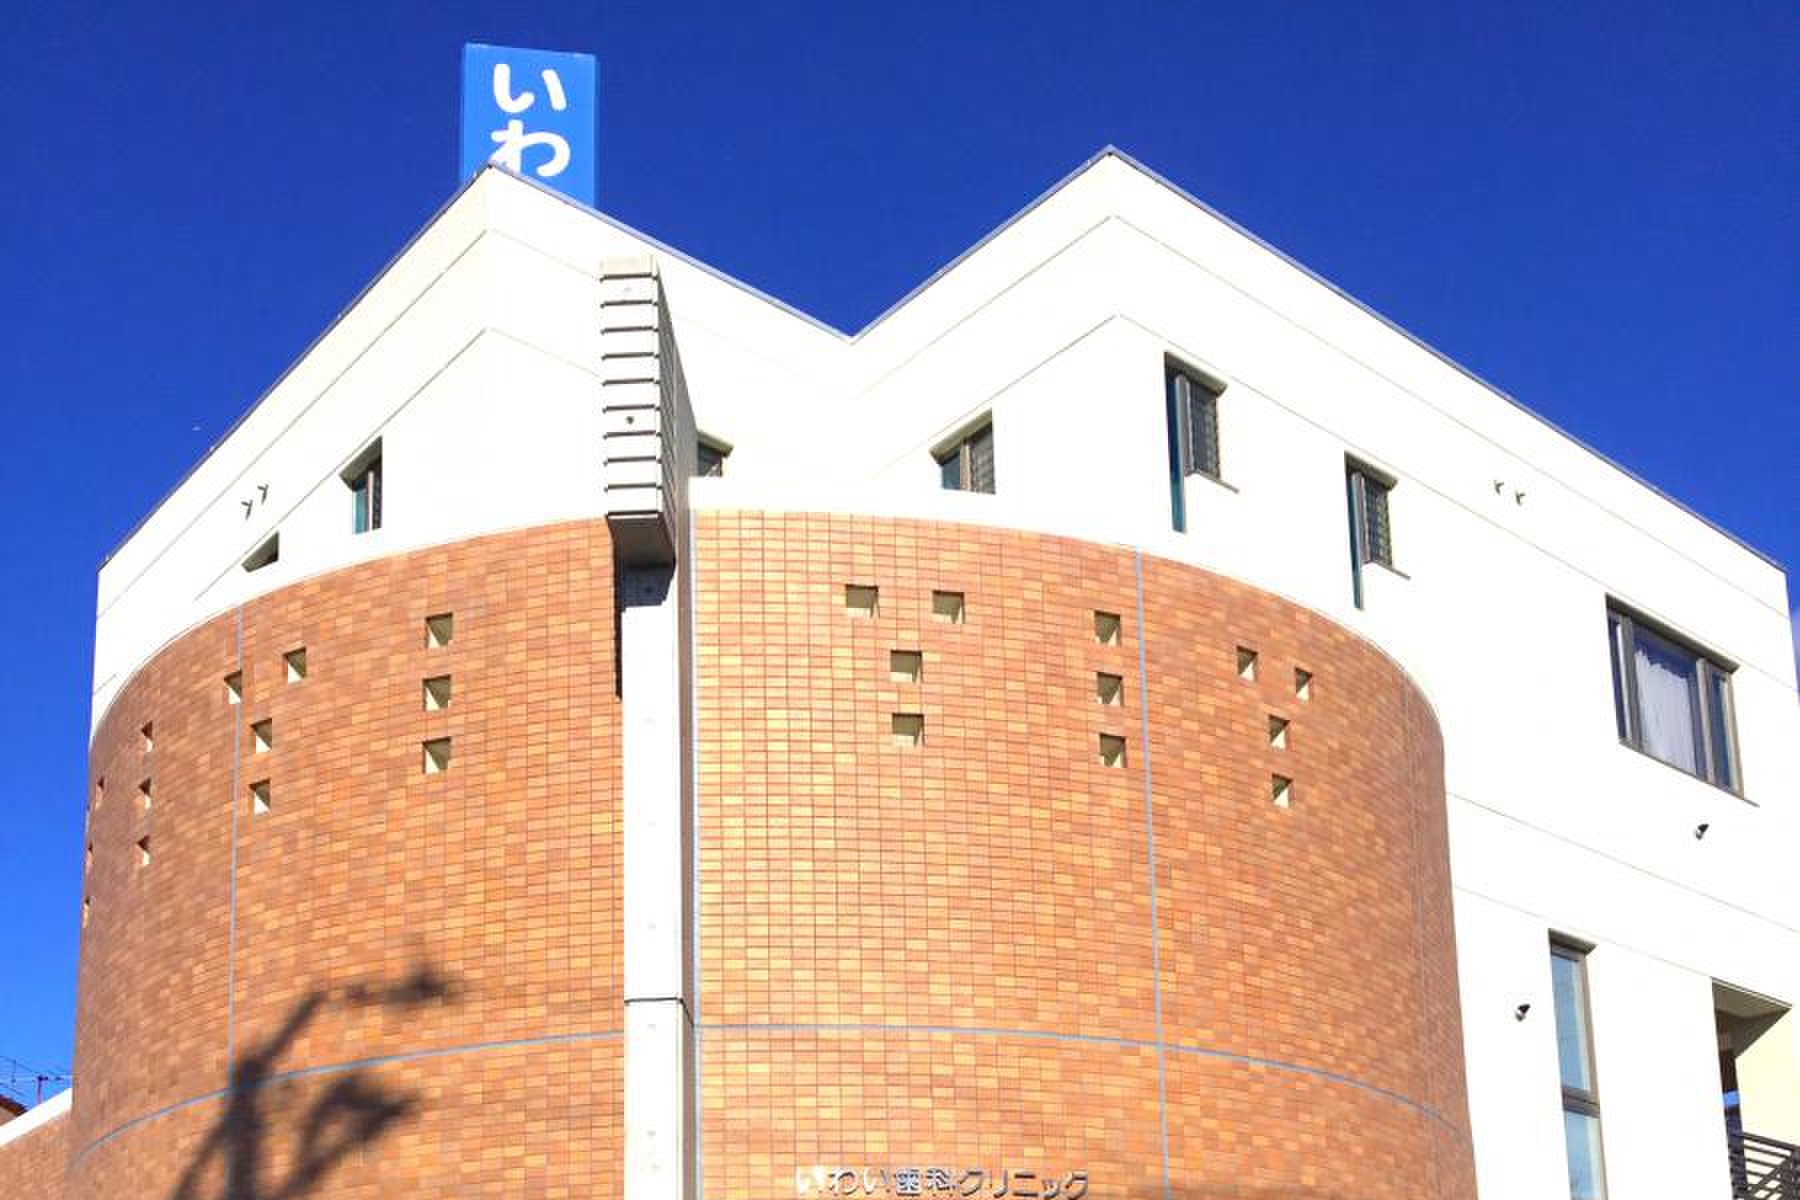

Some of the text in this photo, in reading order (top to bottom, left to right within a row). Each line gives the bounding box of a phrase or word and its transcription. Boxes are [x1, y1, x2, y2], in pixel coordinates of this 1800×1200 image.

[490, 63, 571, 176] いわ
[795, 1167, 1088, 1200] いわい歯科クリニック
